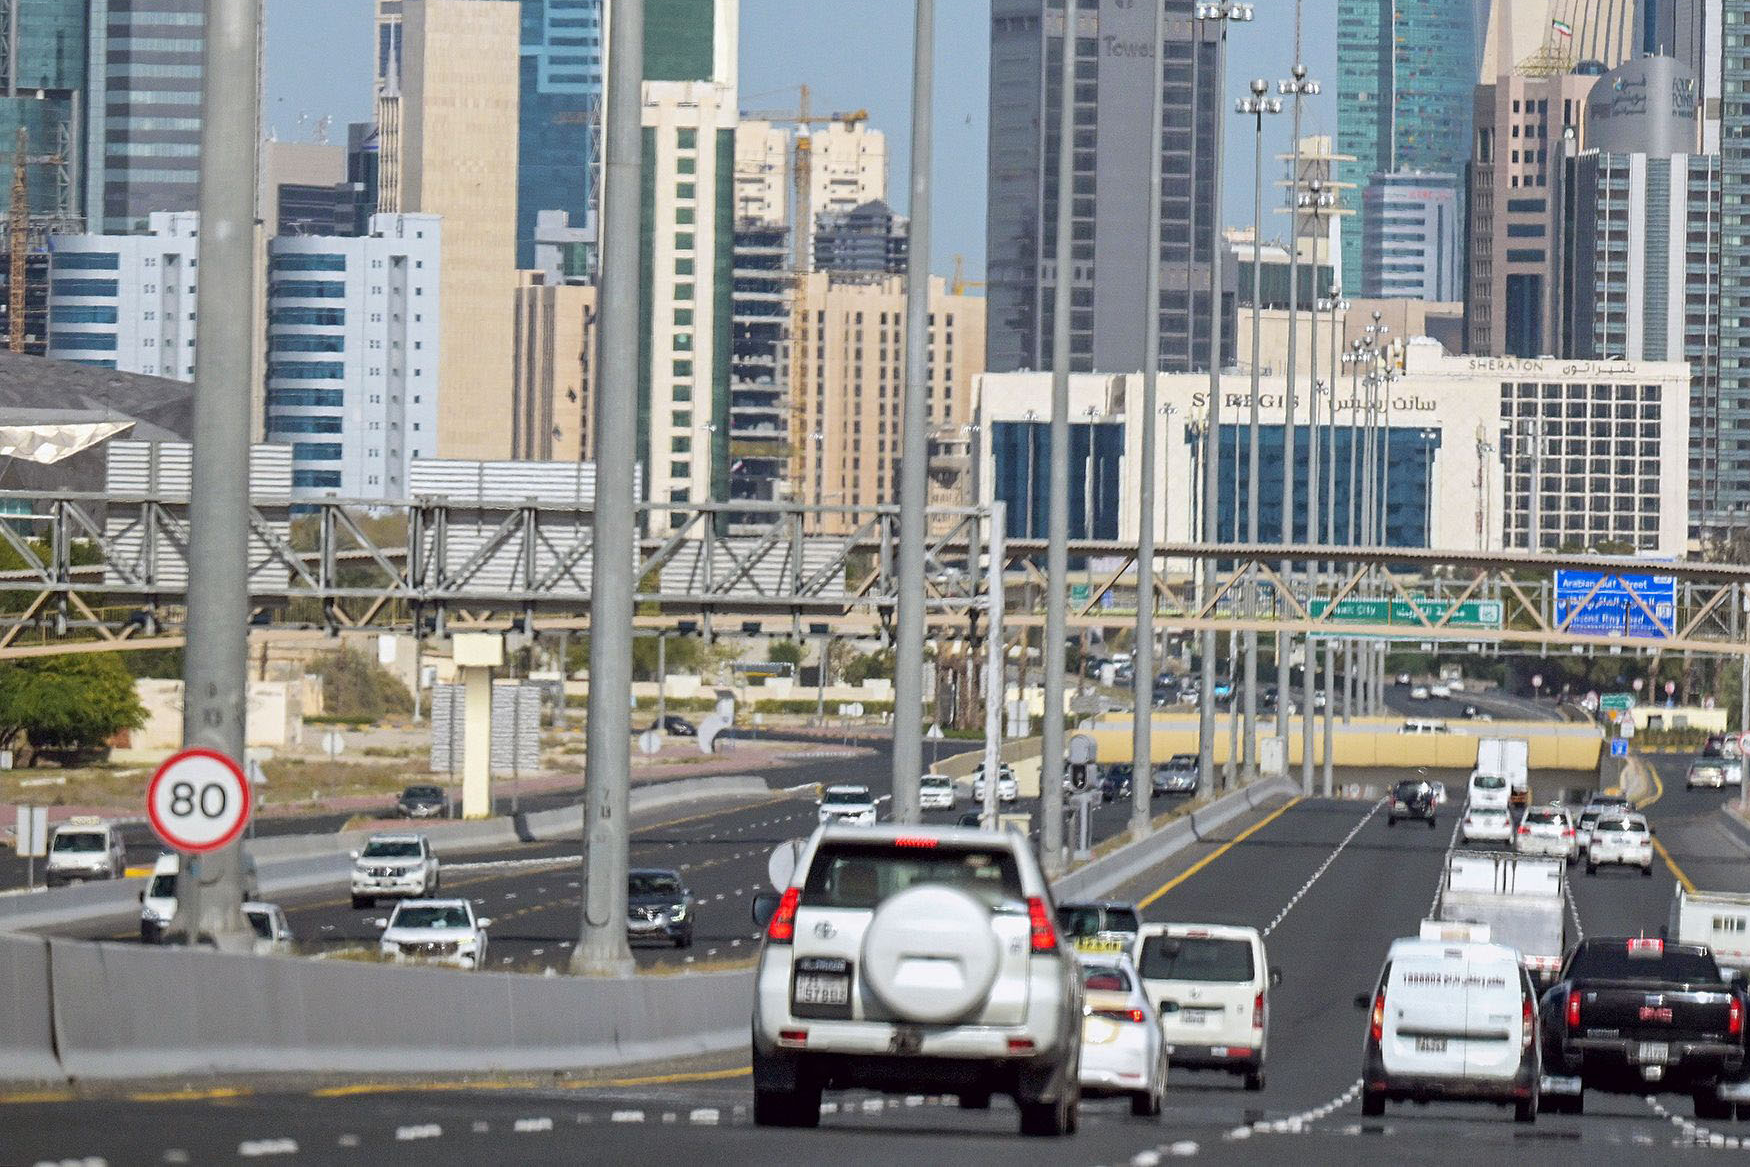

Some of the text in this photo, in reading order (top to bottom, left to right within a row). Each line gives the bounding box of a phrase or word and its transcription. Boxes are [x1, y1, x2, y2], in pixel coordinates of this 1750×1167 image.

[1469, 359, 1544, 371] SHERATON
[1562, 362, 1636, 376] شيراتون
[1391, 396, 1437, 412] سانت
[1562, 578, 1597, 589] Arabian
[171, 782, 226, 818] 80
